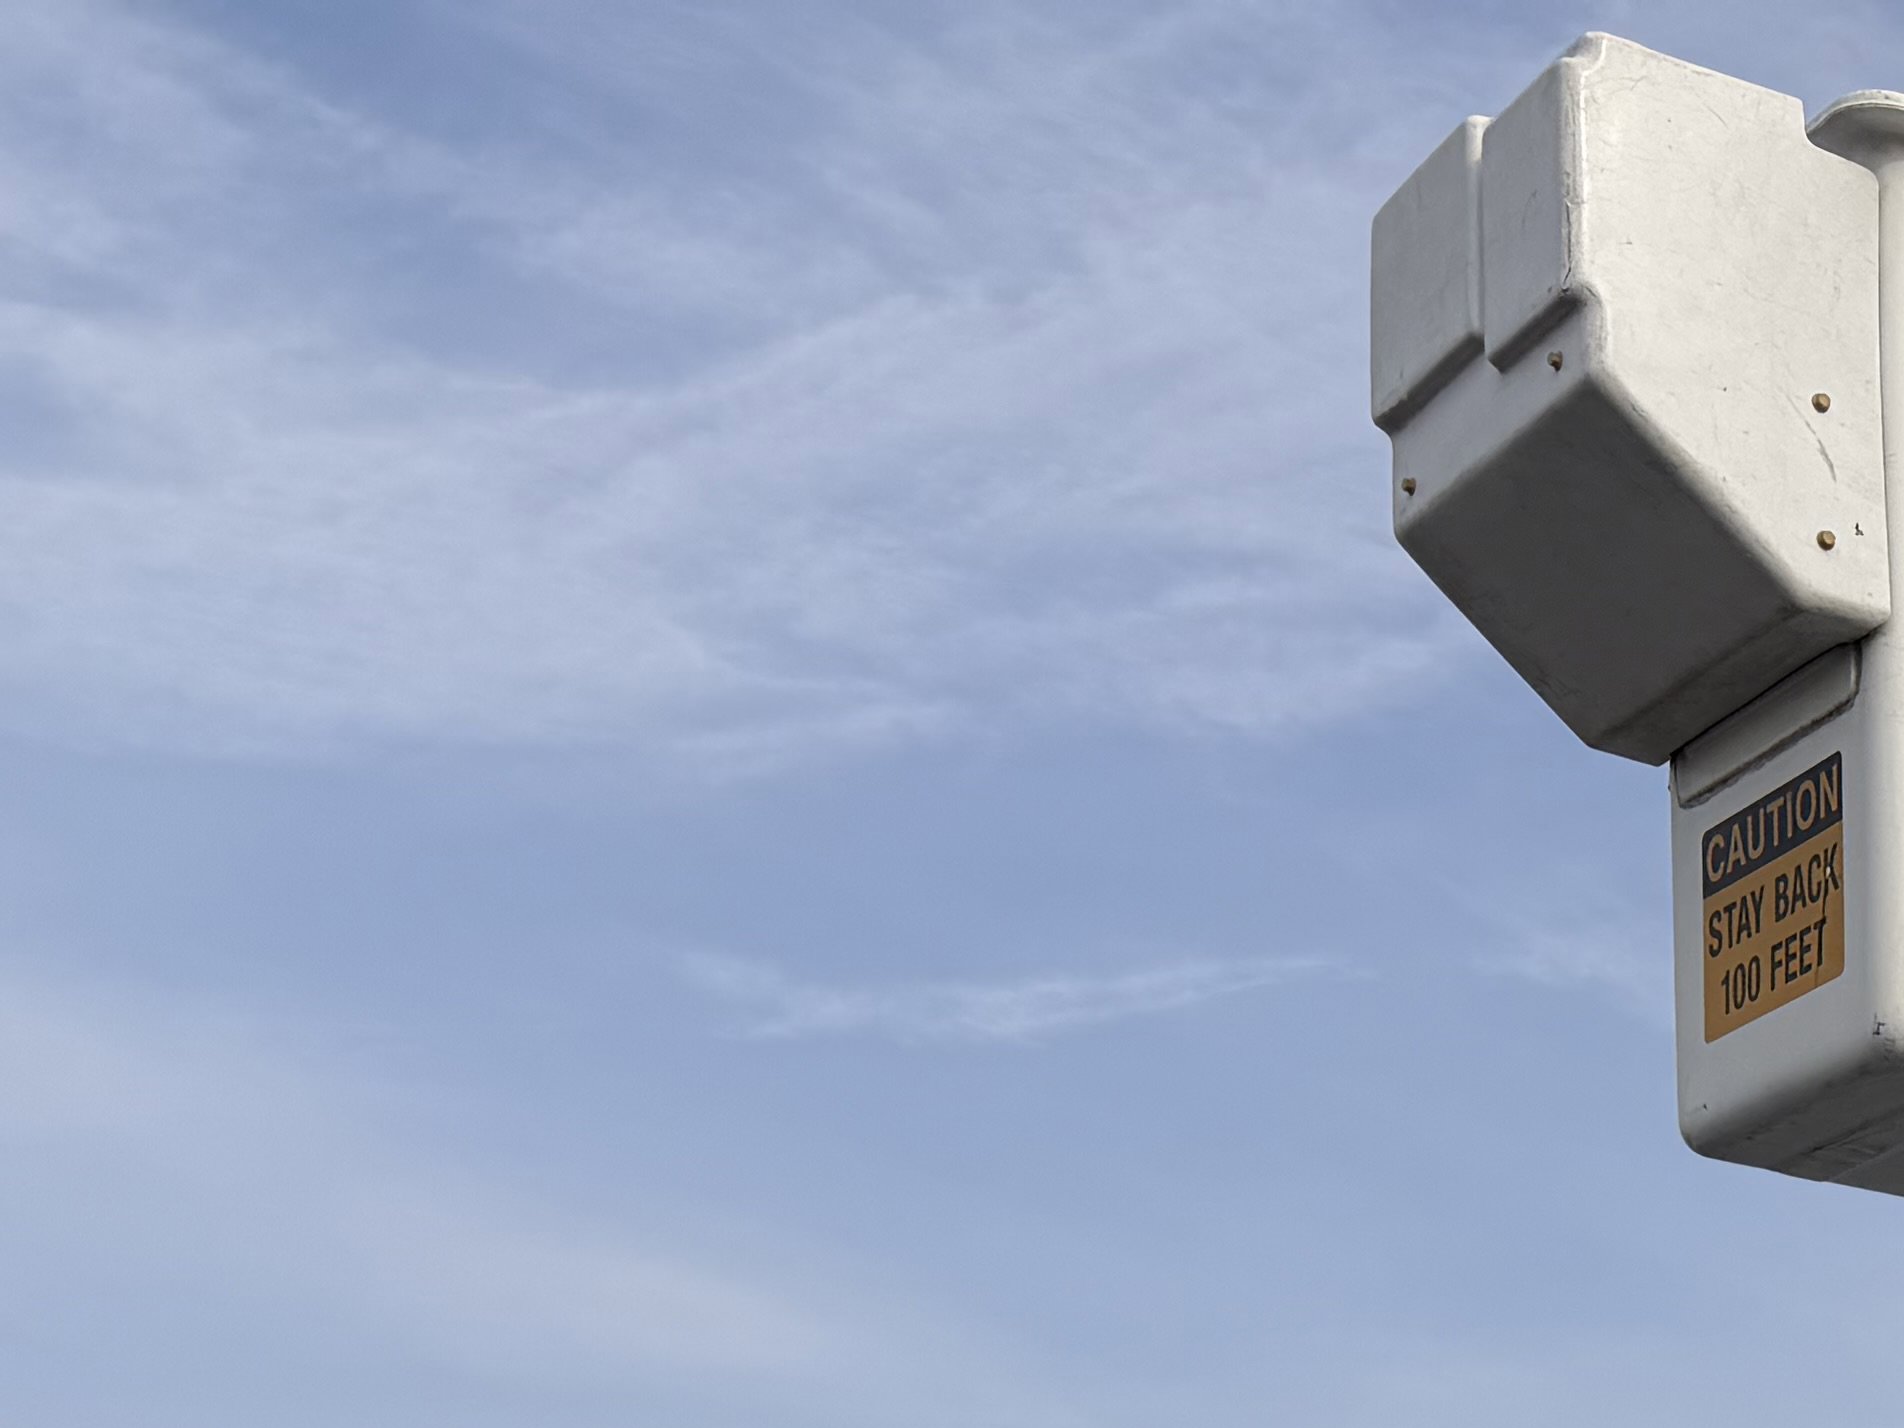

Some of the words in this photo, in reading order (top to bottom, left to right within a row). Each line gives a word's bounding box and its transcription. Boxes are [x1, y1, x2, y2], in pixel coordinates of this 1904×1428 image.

[1705, 764, 1838, 883] CAUTION
[1708, 885, 1764, 958] STAY
[1774, 842, 1840, 923] BACK
[1720, 955, 1761, 1016] 100
[1770, 916, 1827, 991] FEET
